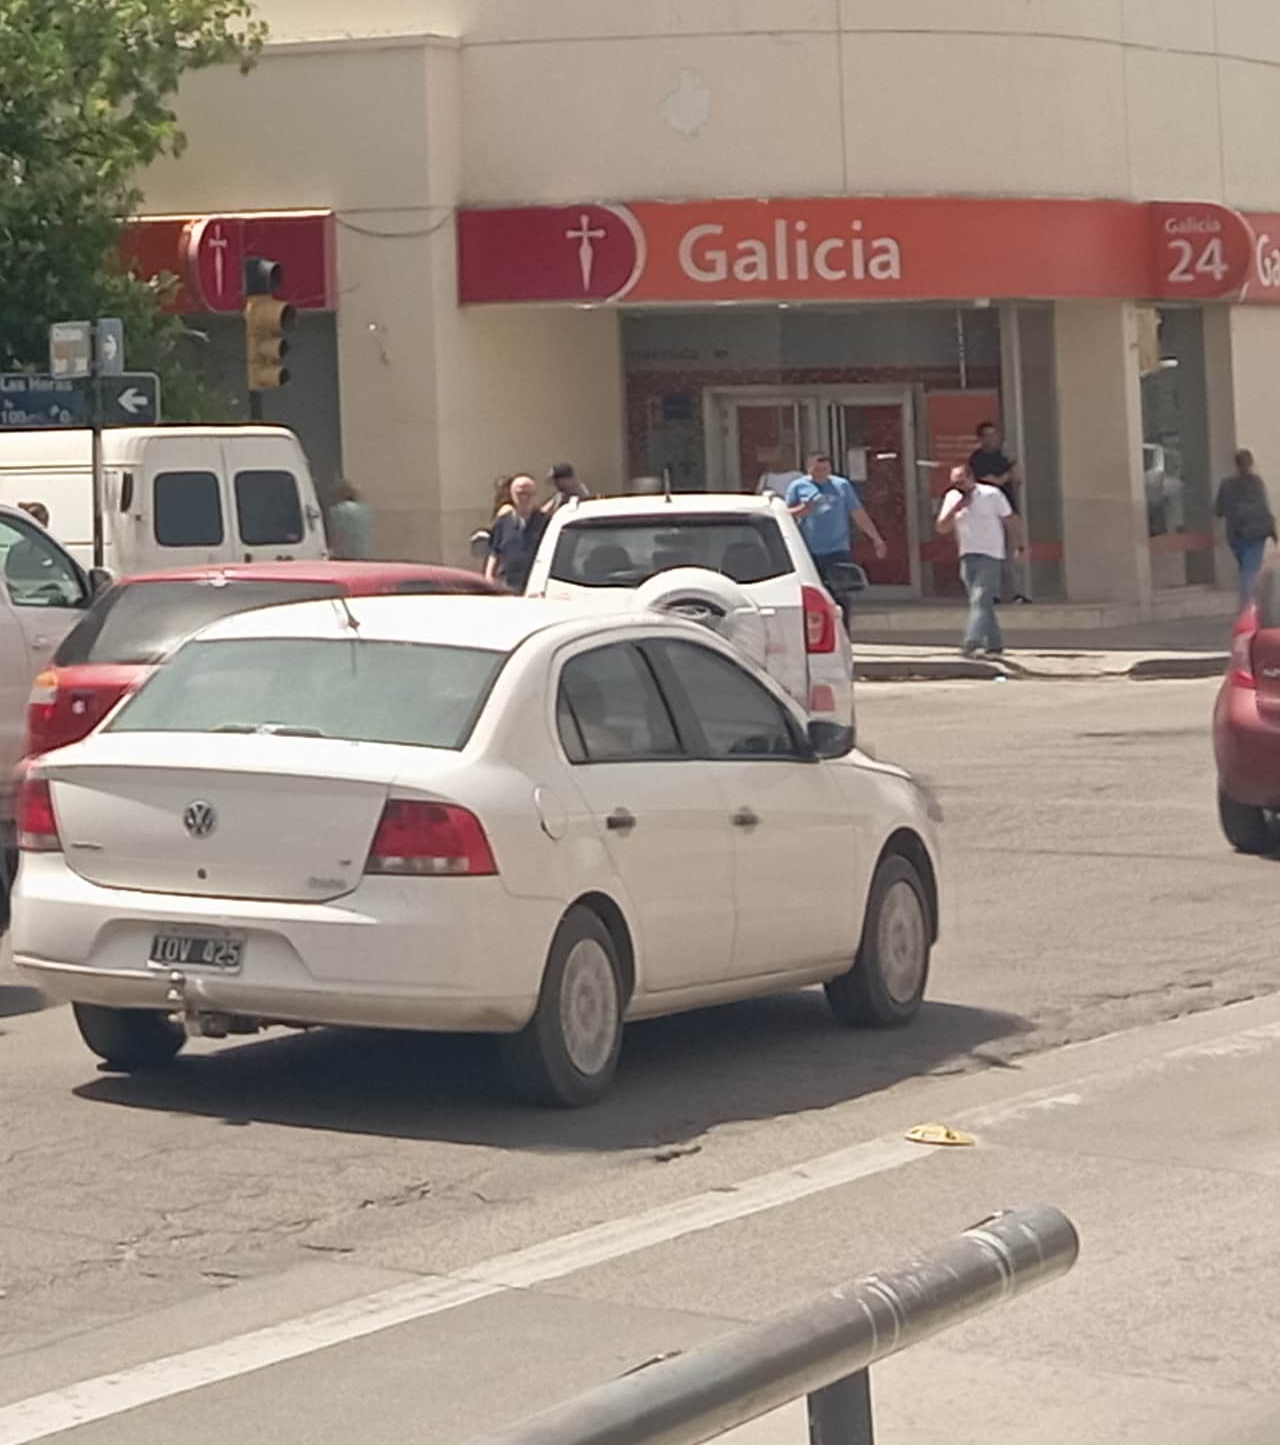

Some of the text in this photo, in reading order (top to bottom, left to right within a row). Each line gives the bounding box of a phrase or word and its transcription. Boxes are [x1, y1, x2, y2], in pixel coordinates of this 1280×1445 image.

[1164, 217, 1222, 235] Galicia
[678, 218, 903, 284] Galicia
[1166, 237, 1230, 283] 24
